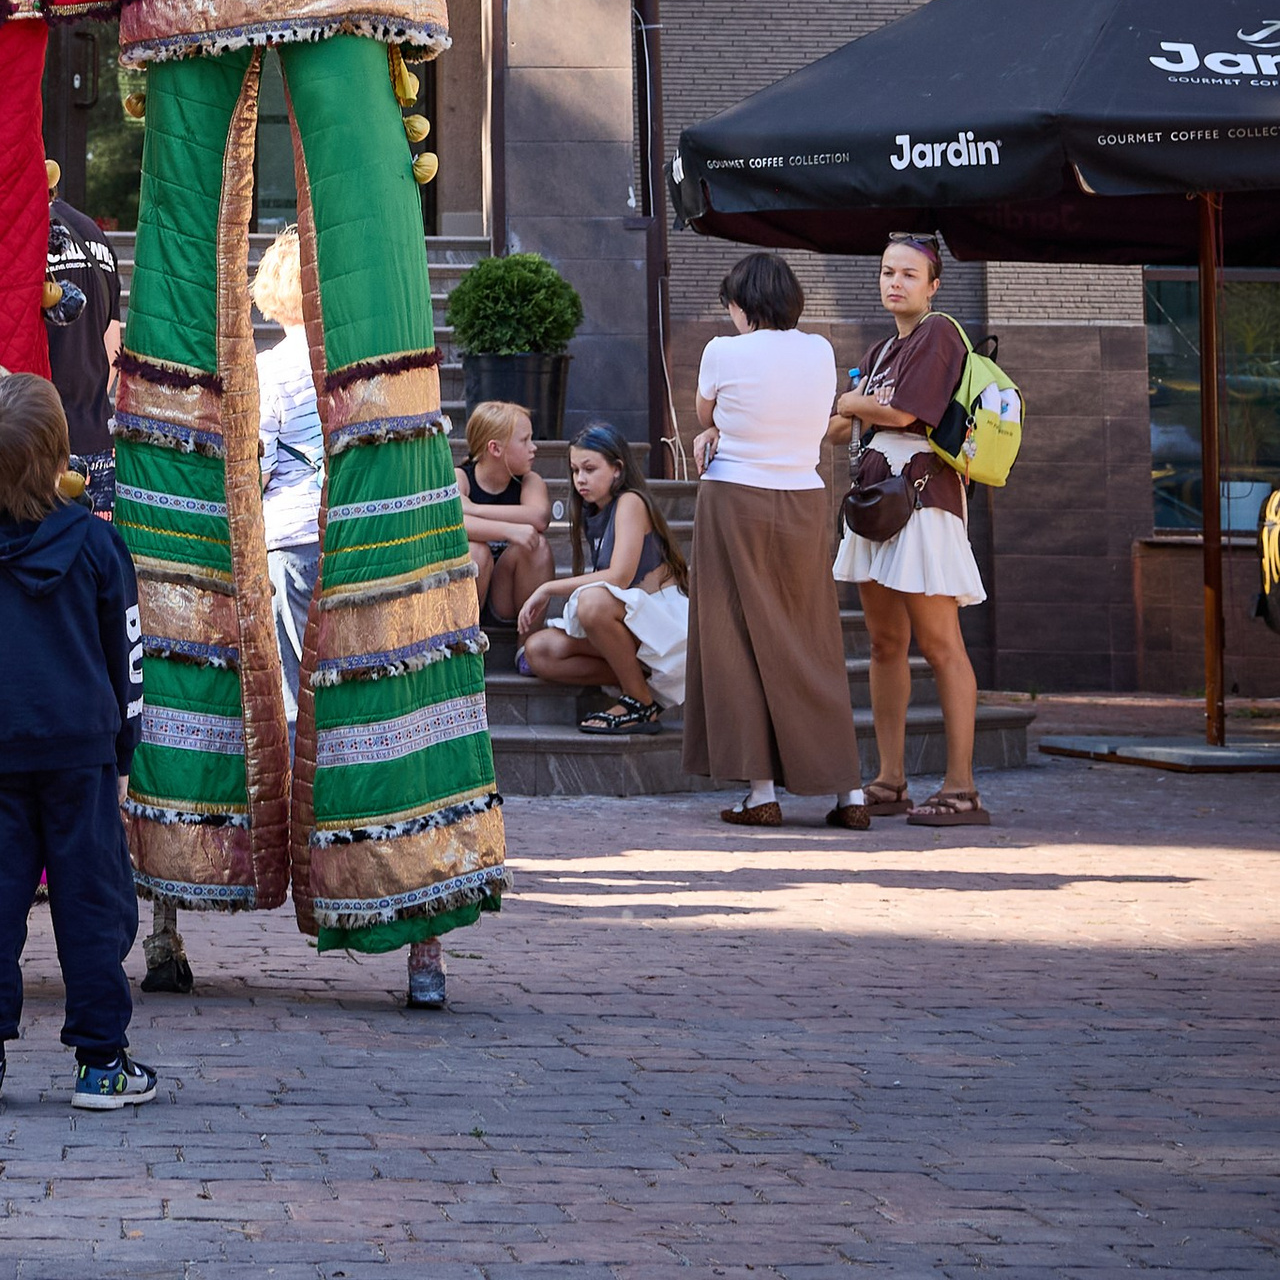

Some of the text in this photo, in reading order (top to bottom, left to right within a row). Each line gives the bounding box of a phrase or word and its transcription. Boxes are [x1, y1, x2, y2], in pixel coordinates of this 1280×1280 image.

[1168, 76, 1240, 86] GOURMET
[1097, 125, 1280, 146] GOURMET COFFEE COLLEC
[706, 152, 850, 170] GOURMET COFFEE COLLECTION
